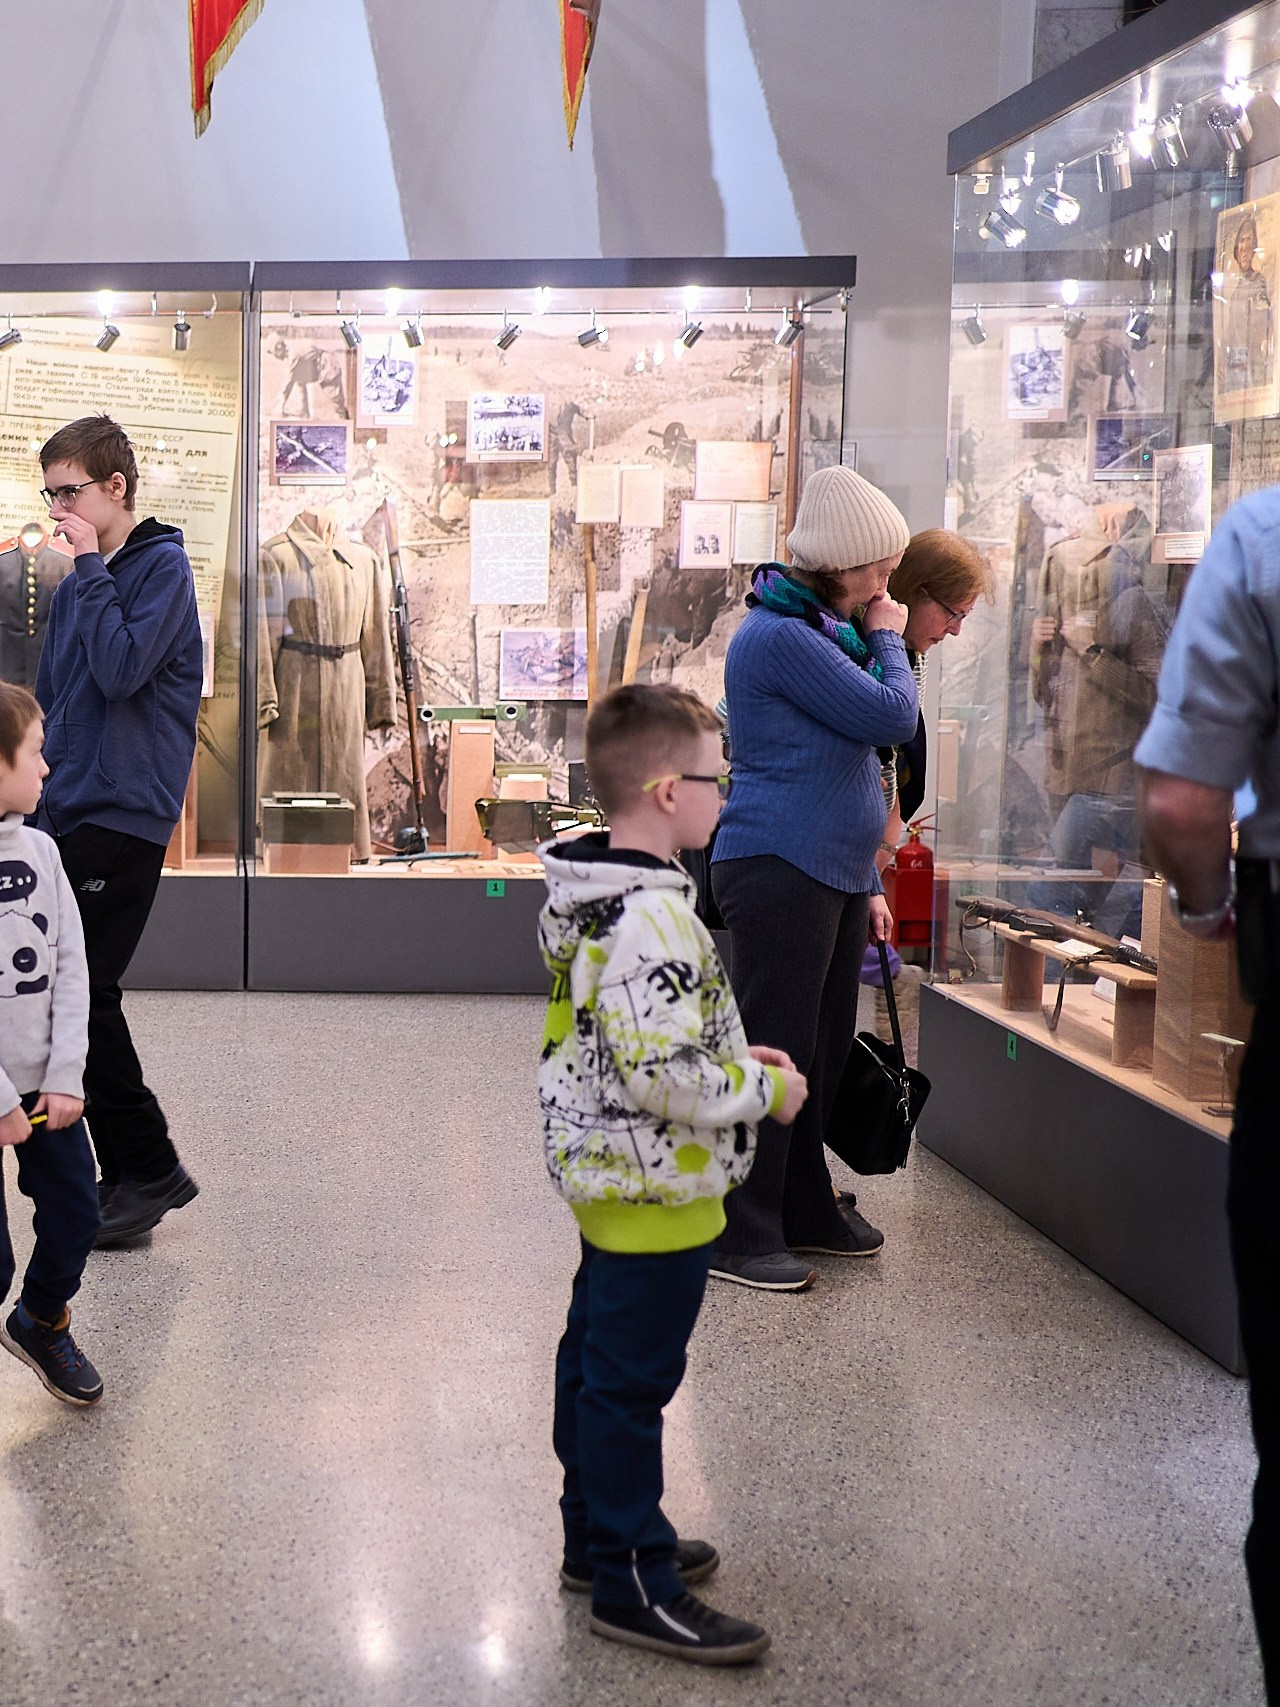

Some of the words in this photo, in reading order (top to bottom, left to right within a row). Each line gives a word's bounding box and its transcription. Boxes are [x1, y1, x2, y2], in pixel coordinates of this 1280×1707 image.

[119, 367, 140, 375] врагу
[145, 368, 179, 377] большой
[81, 371, 88, 379] С
[102, 374, 129, 382] ноября
[133, 376, 151, 384] 1942
[174, 379, 180, 387] 5
[183, 381, 209, 389] января
[212, 382, 230, 391] 1943
[105, 382, 154, 393] Сталинграда
[158, 388, 180, 396] взято
[48, 388, 84, 397] офицеров
[137, 393, 149, 401] За
[152, 396, 175, 404] время
[203, 399, 208, 407] 5
[210, 401, 237, 409] января
[41, 396, 80, 405] противник
[82, 399, 113, 407] потерял
[116, 402, 141, 410] только
[144, 404, 175, 413] убитыми
[177, 407, 203, 415] свыше
[162, 434, 185, 443] СССР
[185, 449, 209, 458] для
[493, 883, 498, 892] 1
